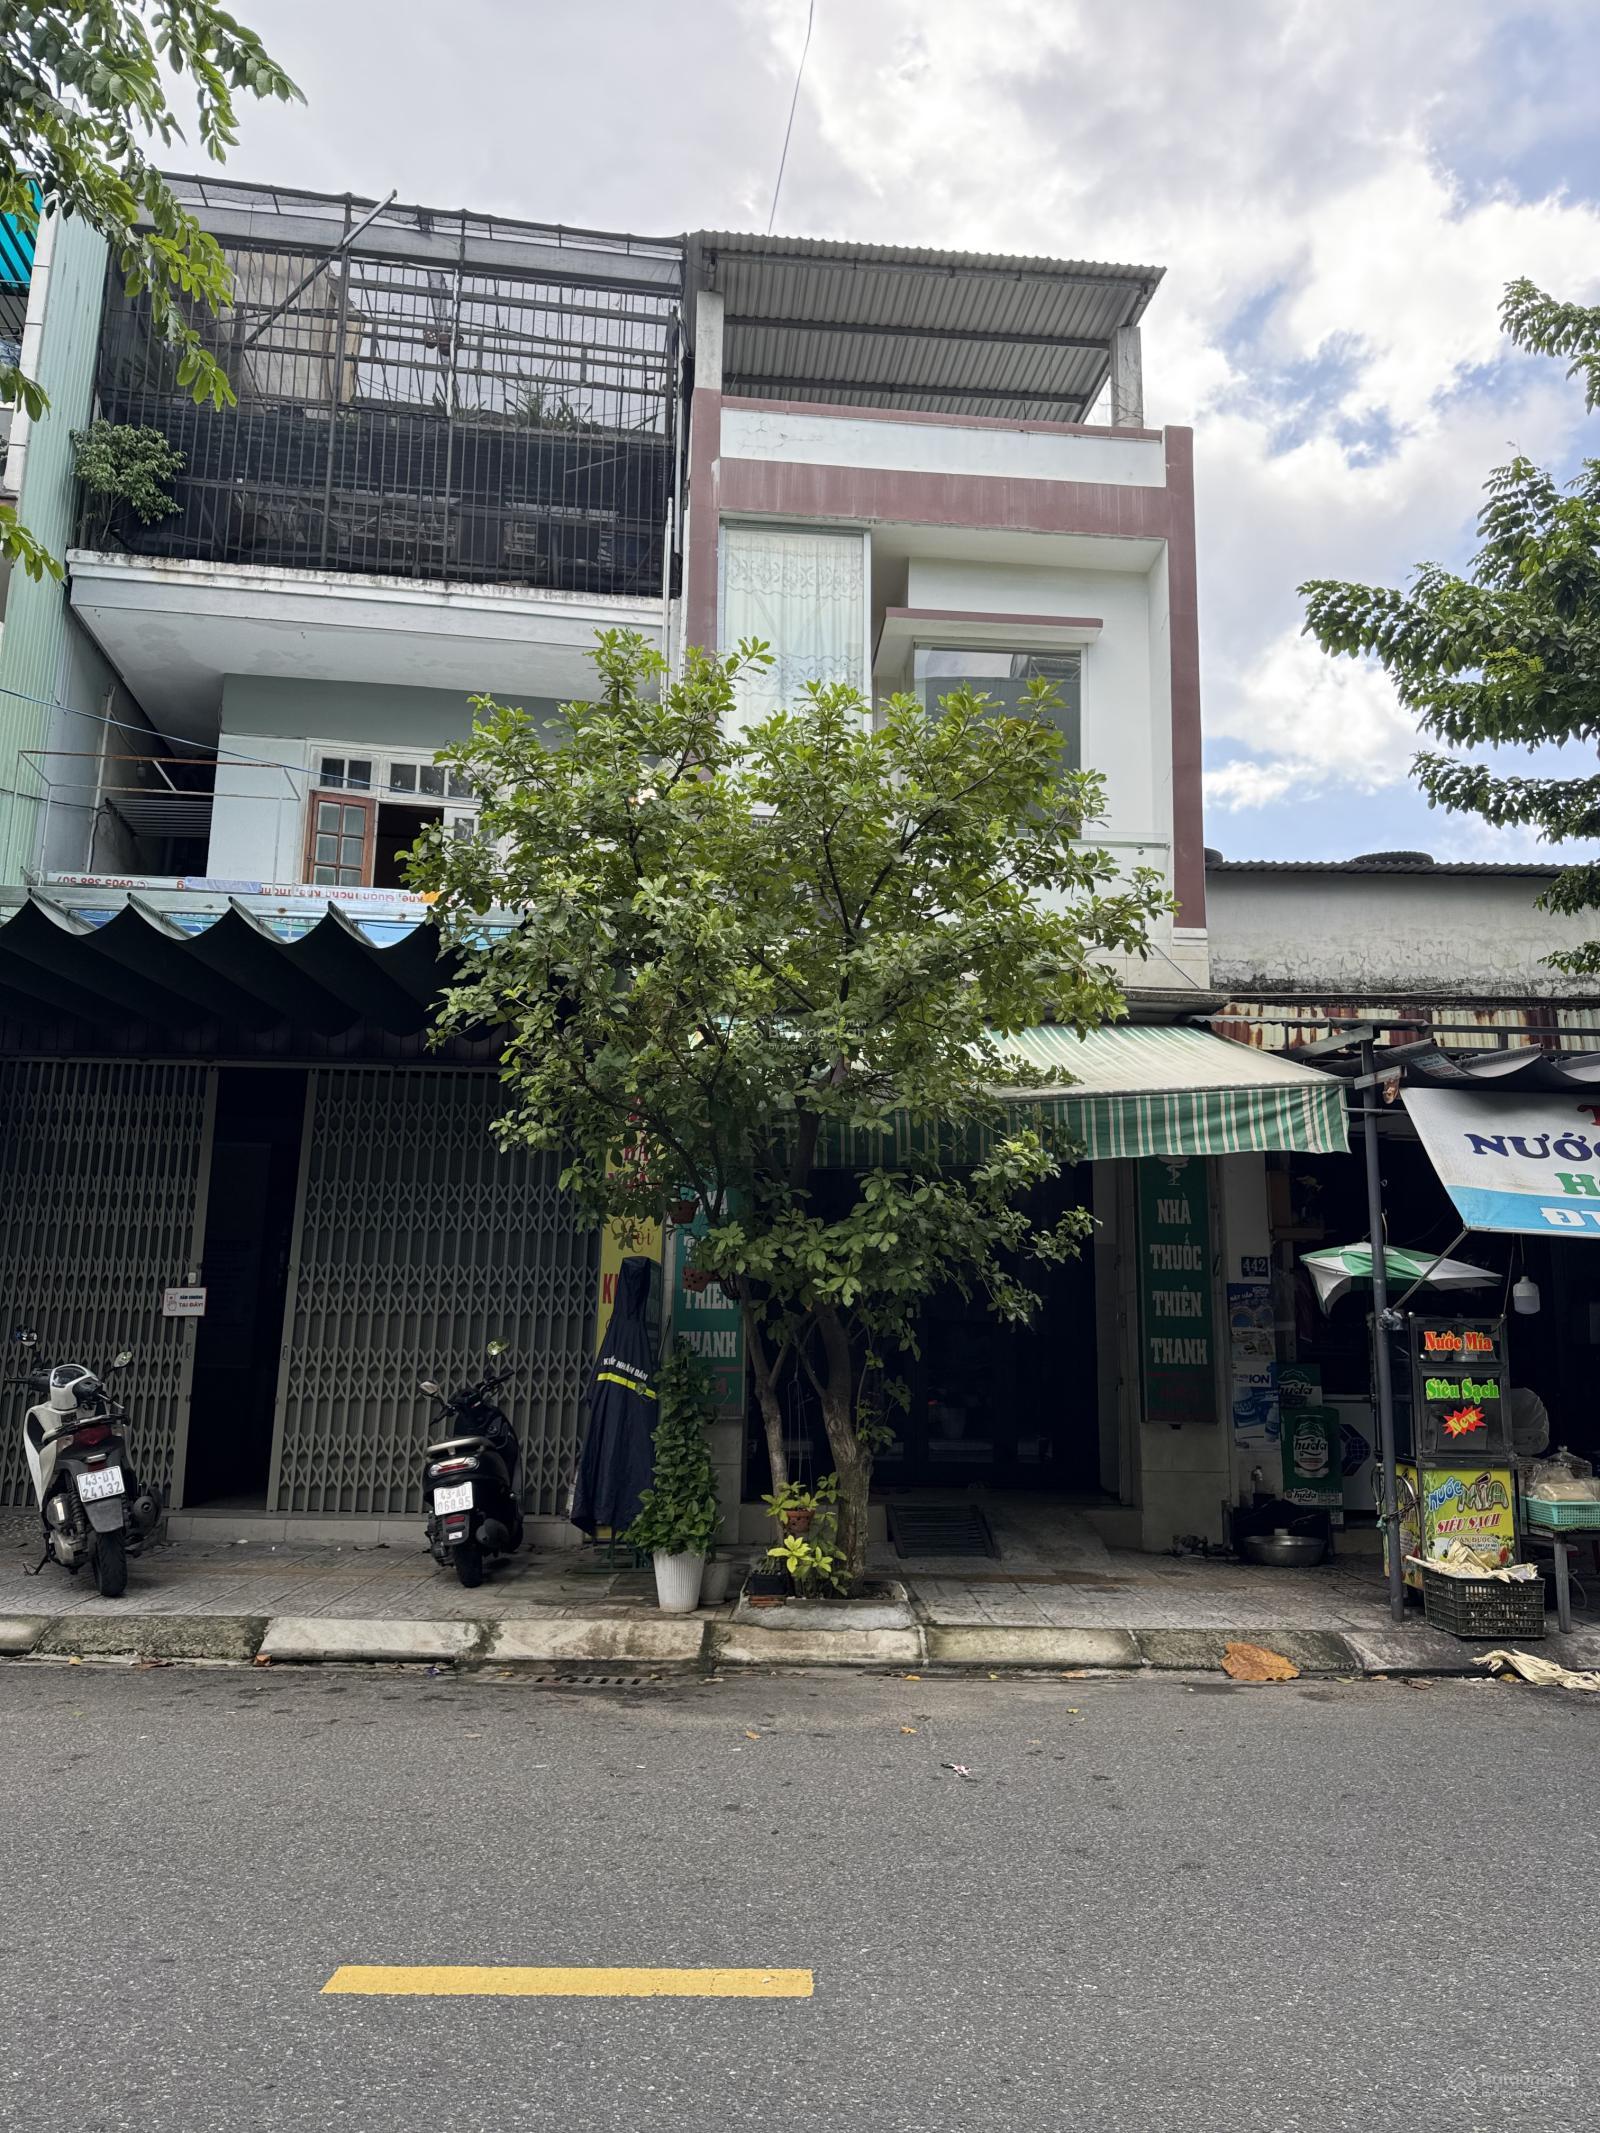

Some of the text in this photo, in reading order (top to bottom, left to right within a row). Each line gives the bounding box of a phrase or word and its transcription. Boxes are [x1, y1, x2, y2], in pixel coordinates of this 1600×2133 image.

[1463, 1132, 1600, 1162] NƯỚ
[1156, 1193, 1192, 1225] NHÀ
[1149, 1233, 1203, 1271] THUỐC
[1242, 1258, 1267, 1272] 442
[1152, 1285, 1203, 1317] THIÊN
[1150, 1337, 1208, 1365] THANH
[1424, 1330, 1494, 1351] Nước Mía
[1425, 1376, 1500, 1405] Siêu Sạch
[1446, 1409, 1478, 1433] New
[82, 1480, 124, 1501] 241.32
